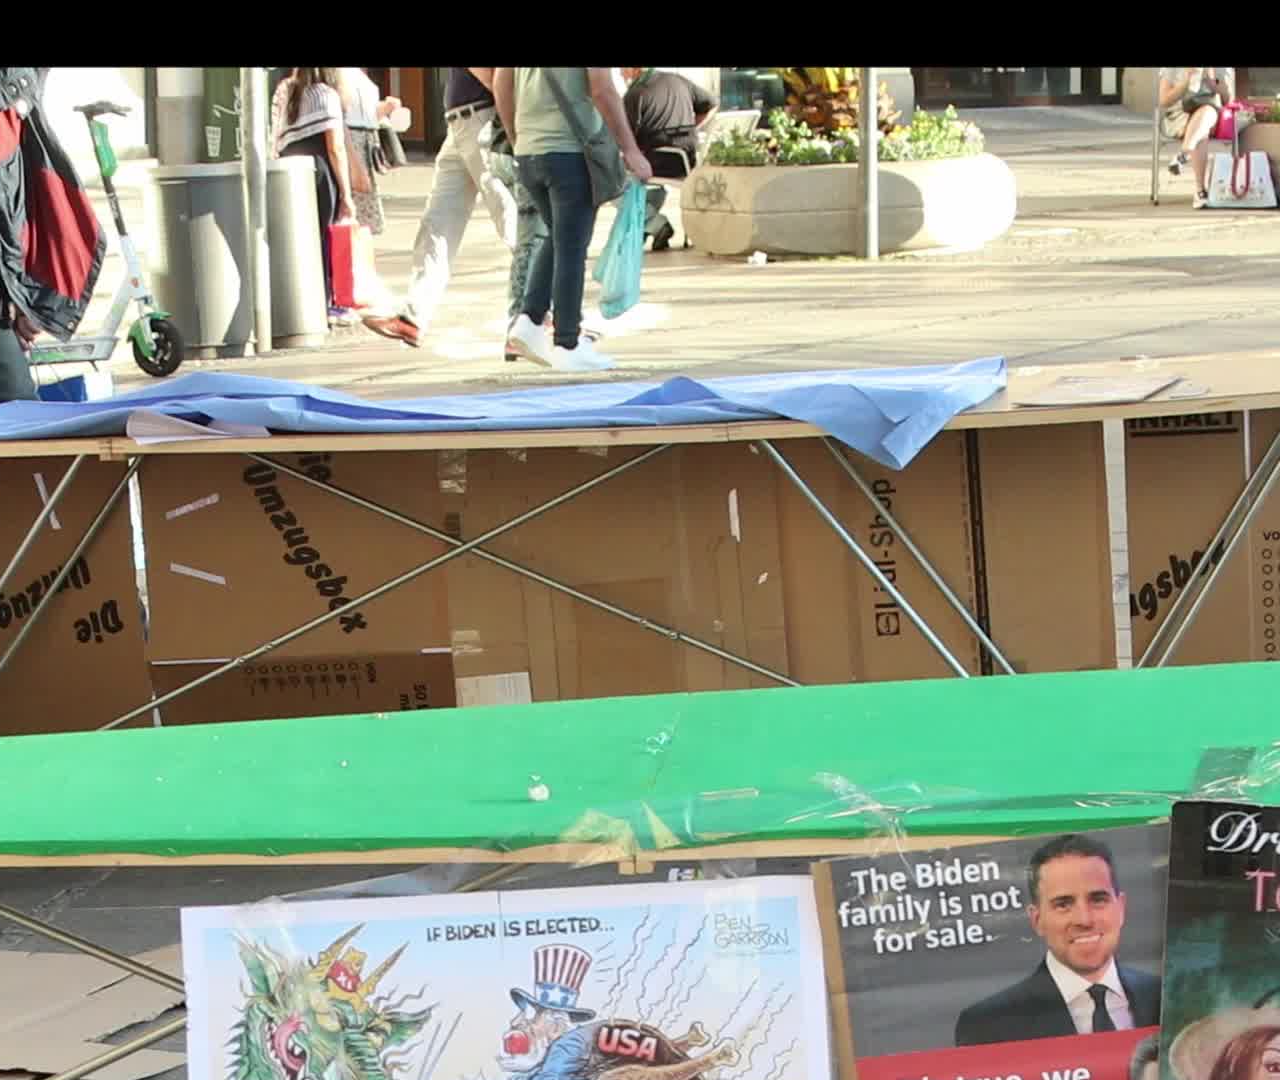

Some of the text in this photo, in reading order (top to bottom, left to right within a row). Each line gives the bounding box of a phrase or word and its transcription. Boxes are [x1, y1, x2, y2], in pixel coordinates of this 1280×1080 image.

[243, 462, 368, 634] Umzugsbox
[73, 599, 124, 644] Die
[851, 858, 1001, 898] The Biden
[838, 887, 1023, 930] family is not
[427, 928, 441, 942] IF
[446, 923, 496, 941] BIDEN
[504, 920, 520, 937] IS
[873, 921, 995, 955] for sale.
[598, 1025, 658, 1062] USA
